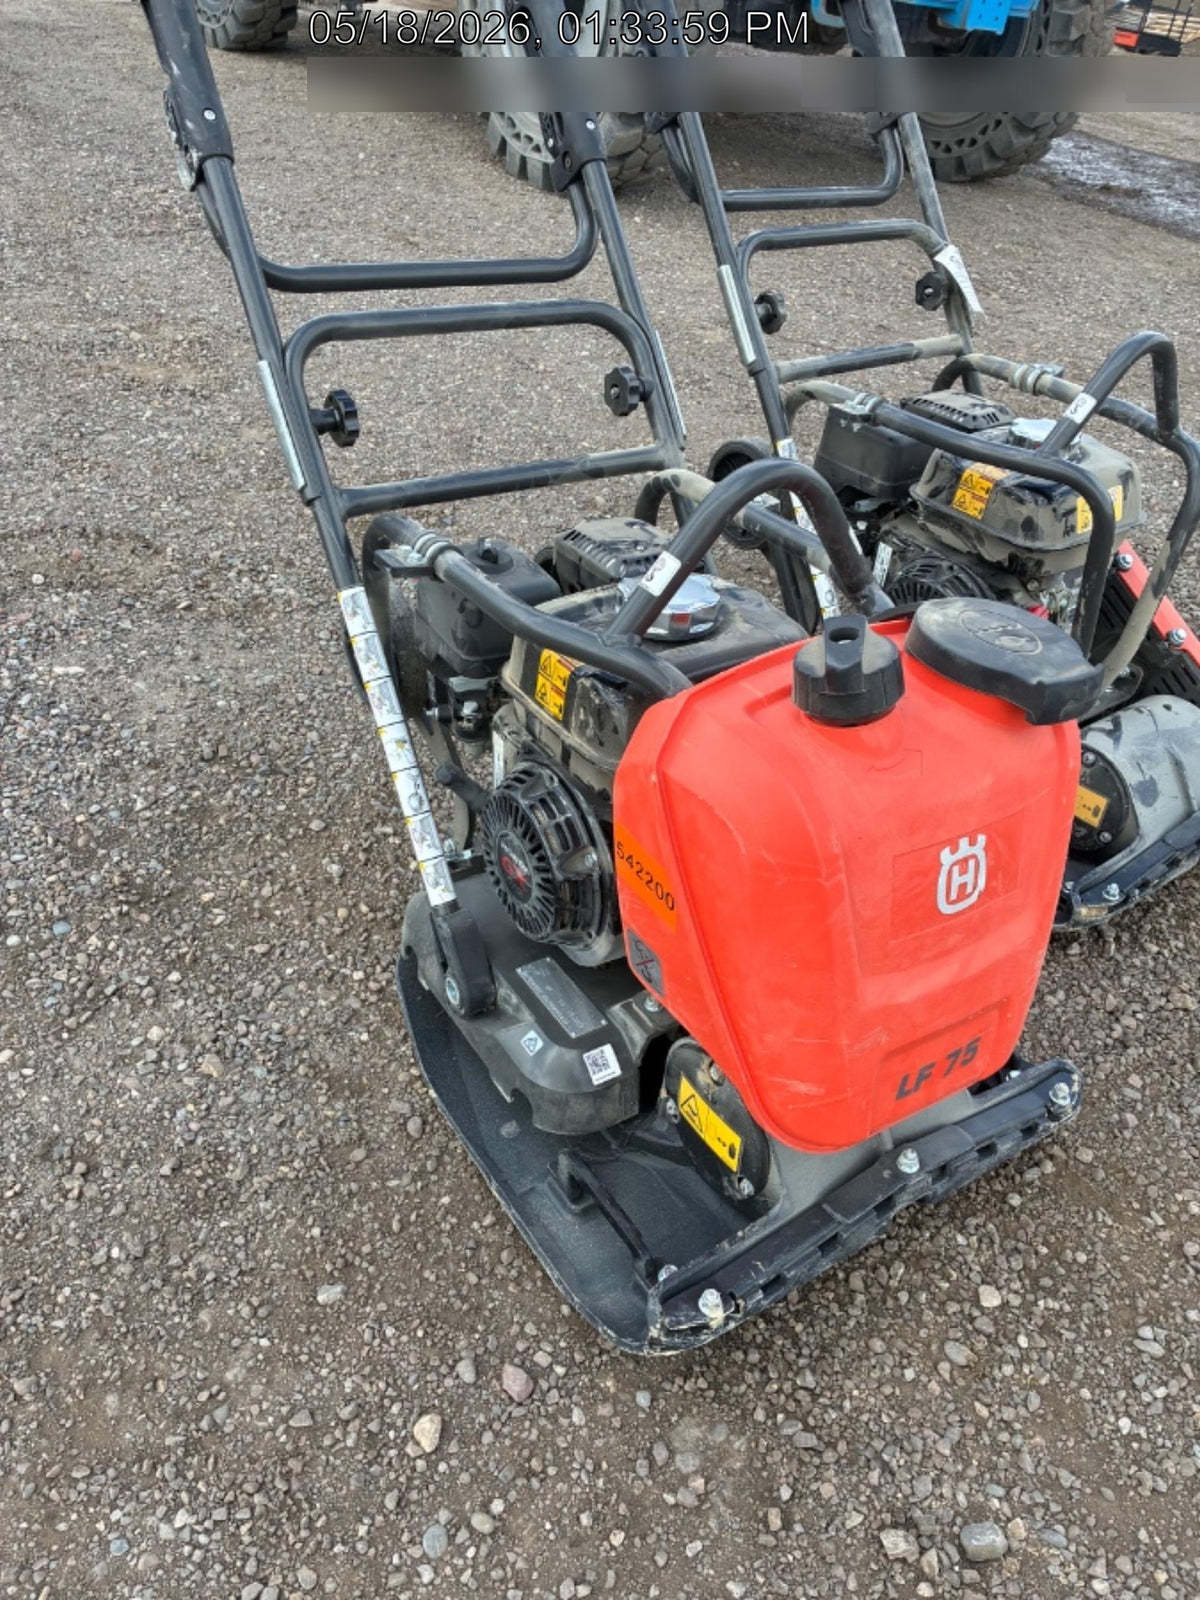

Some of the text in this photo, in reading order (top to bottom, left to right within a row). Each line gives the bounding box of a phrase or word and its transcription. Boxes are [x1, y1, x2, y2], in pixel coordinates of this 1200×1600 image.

[615, 841, 675, 911] 542200
[895, 1035, 982, 1101] LF 75
